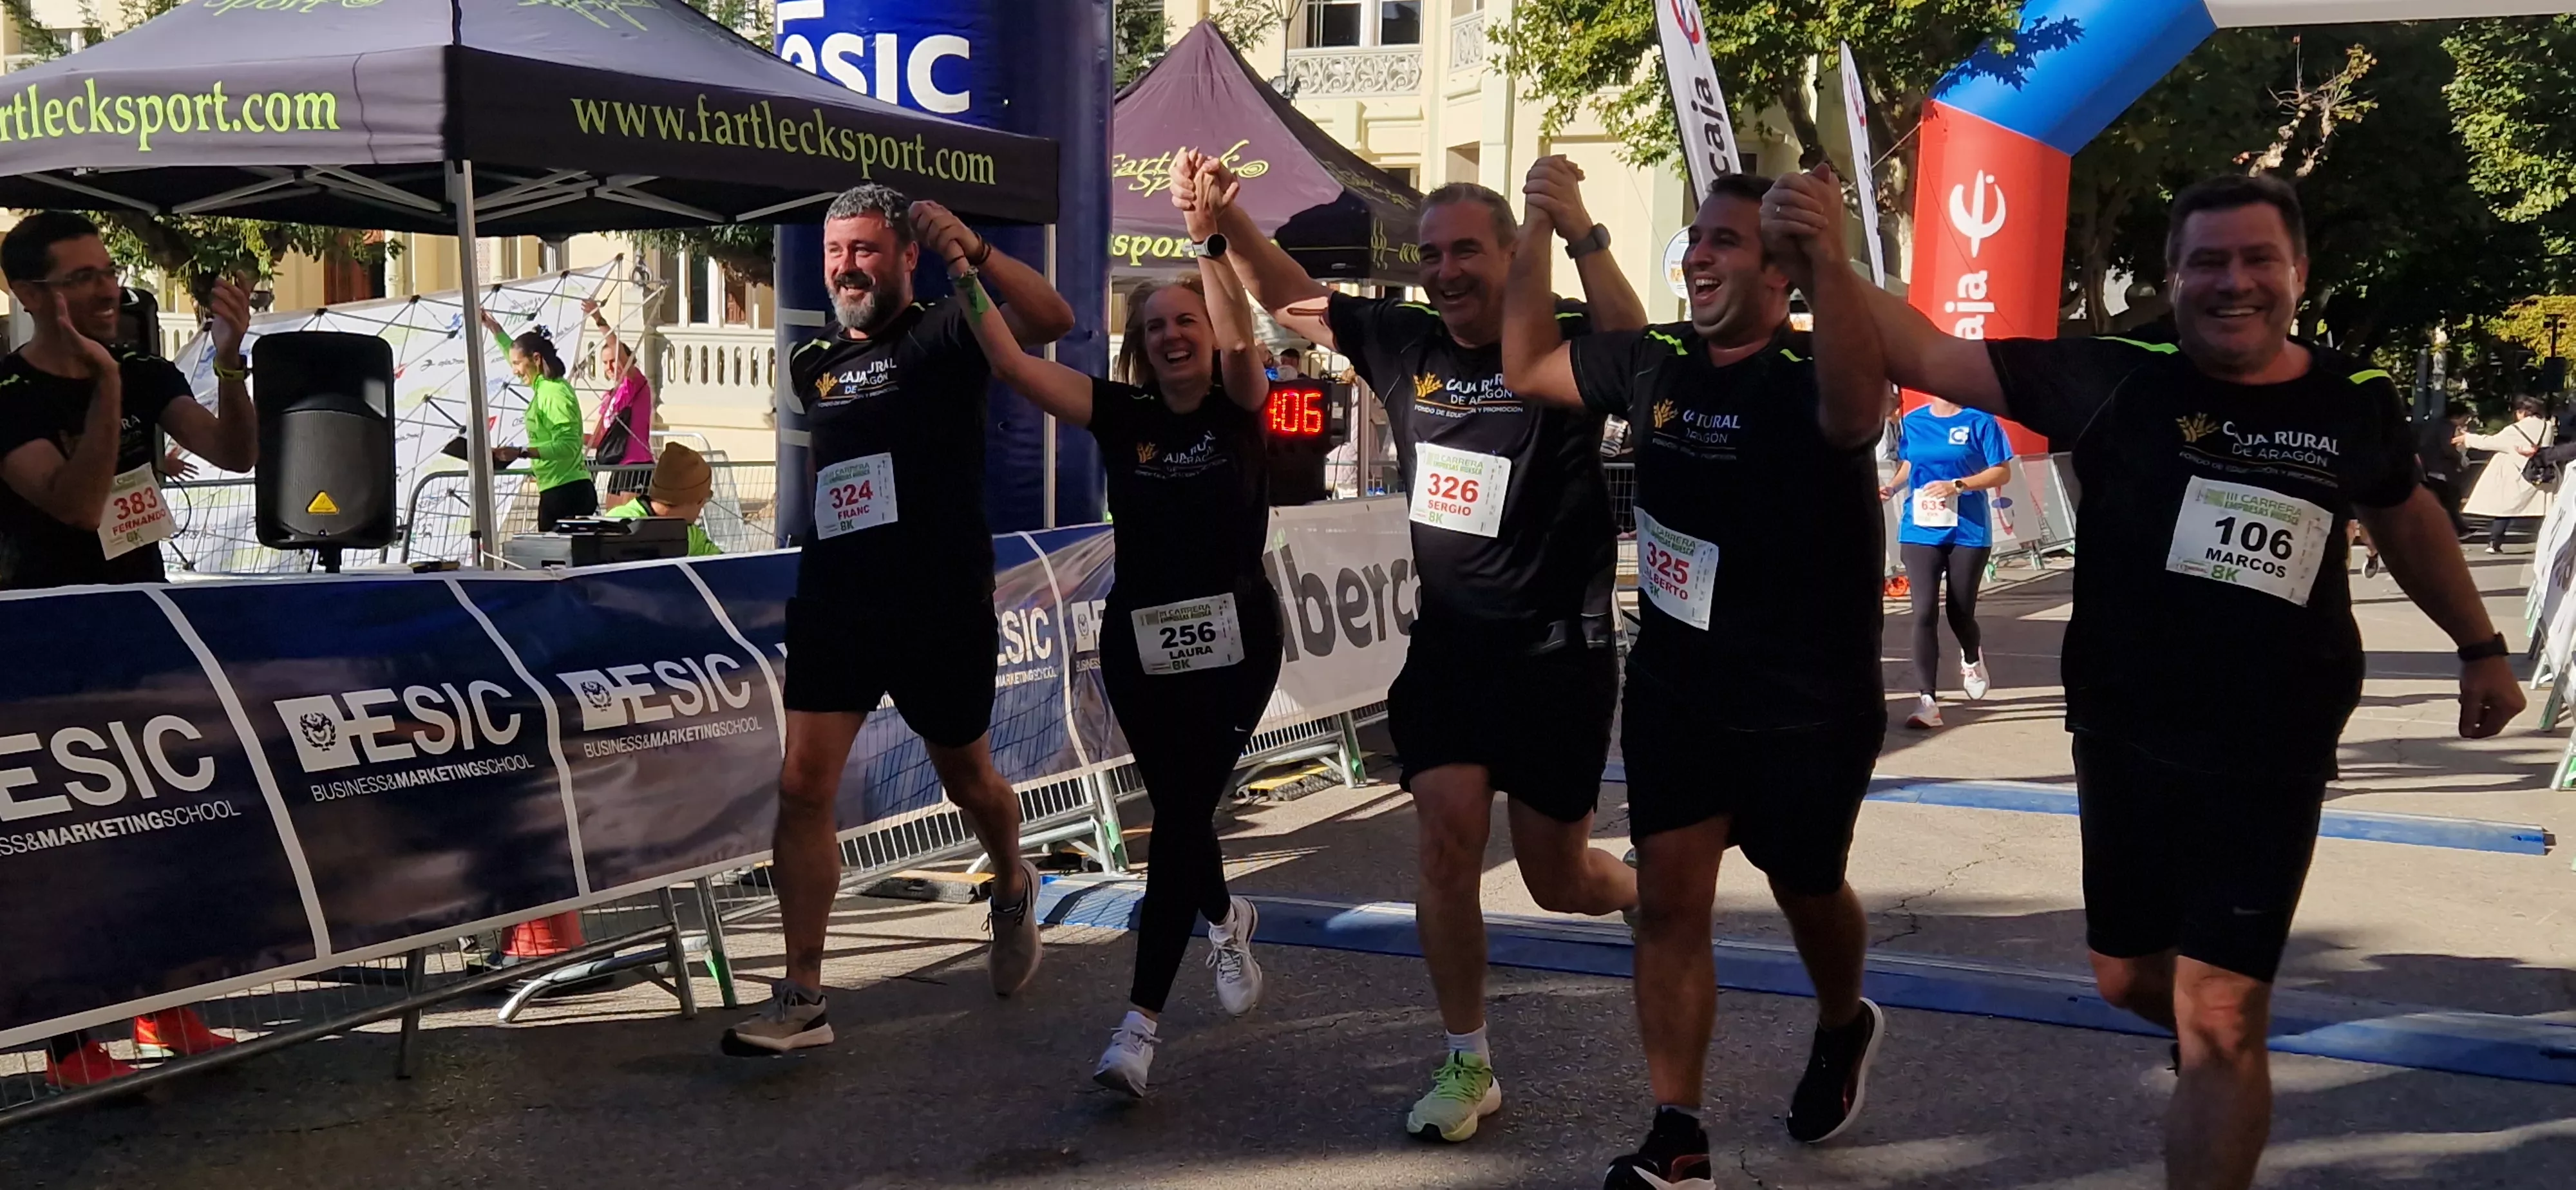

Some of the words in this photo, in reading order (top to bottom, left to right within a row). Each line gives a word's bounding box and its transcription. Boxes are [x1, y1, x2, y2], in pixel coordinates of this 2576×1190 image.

[570, 93, 996, 185] www.fartlecksport.com
[844, 384, 858, 395] DE
[1450, 393, 1466, 405] DE
[2231, 442, 2253, 458] DE
[2257, 448, 2329, 468] ARAGÓN
[2275, 431, 2340, 456] RURAL
[829, 479, 875, 509] 324
[1427, 473, 1479, 503] 326
[113, 486, 157, 520] 383
[838, 504, 871, 521] FRANC
[1428, 499, 1472, 516] SERGIO
[2240, 494, 2303, 516] CARRERA
[112, 508, 167, 536] FERNANDO
[840, 520, 855, 532] 8K
[1428, 511, 1443, 524] 8K
[2215, 516, 2294, 561] 106
[1646, 541, 1690, 585] 325
[2206, 547, 2288, 579] MARCOS
[2210, 564, 2242, 583] 8K
[1159, 621, 1217, 649] 256
[1169, 645, 1214, 659] LAURA
[616, 653, 751, 724] ESIC
[341, 680, 521, 764] ESIC
[583, 716, 762, 759] BUSINESS&MARKETINGSCHOOL
[0, 715, 215, 822] ESIC
[311, 754, 535, 802] BUSINESS&MARKETINGSCHOOL
